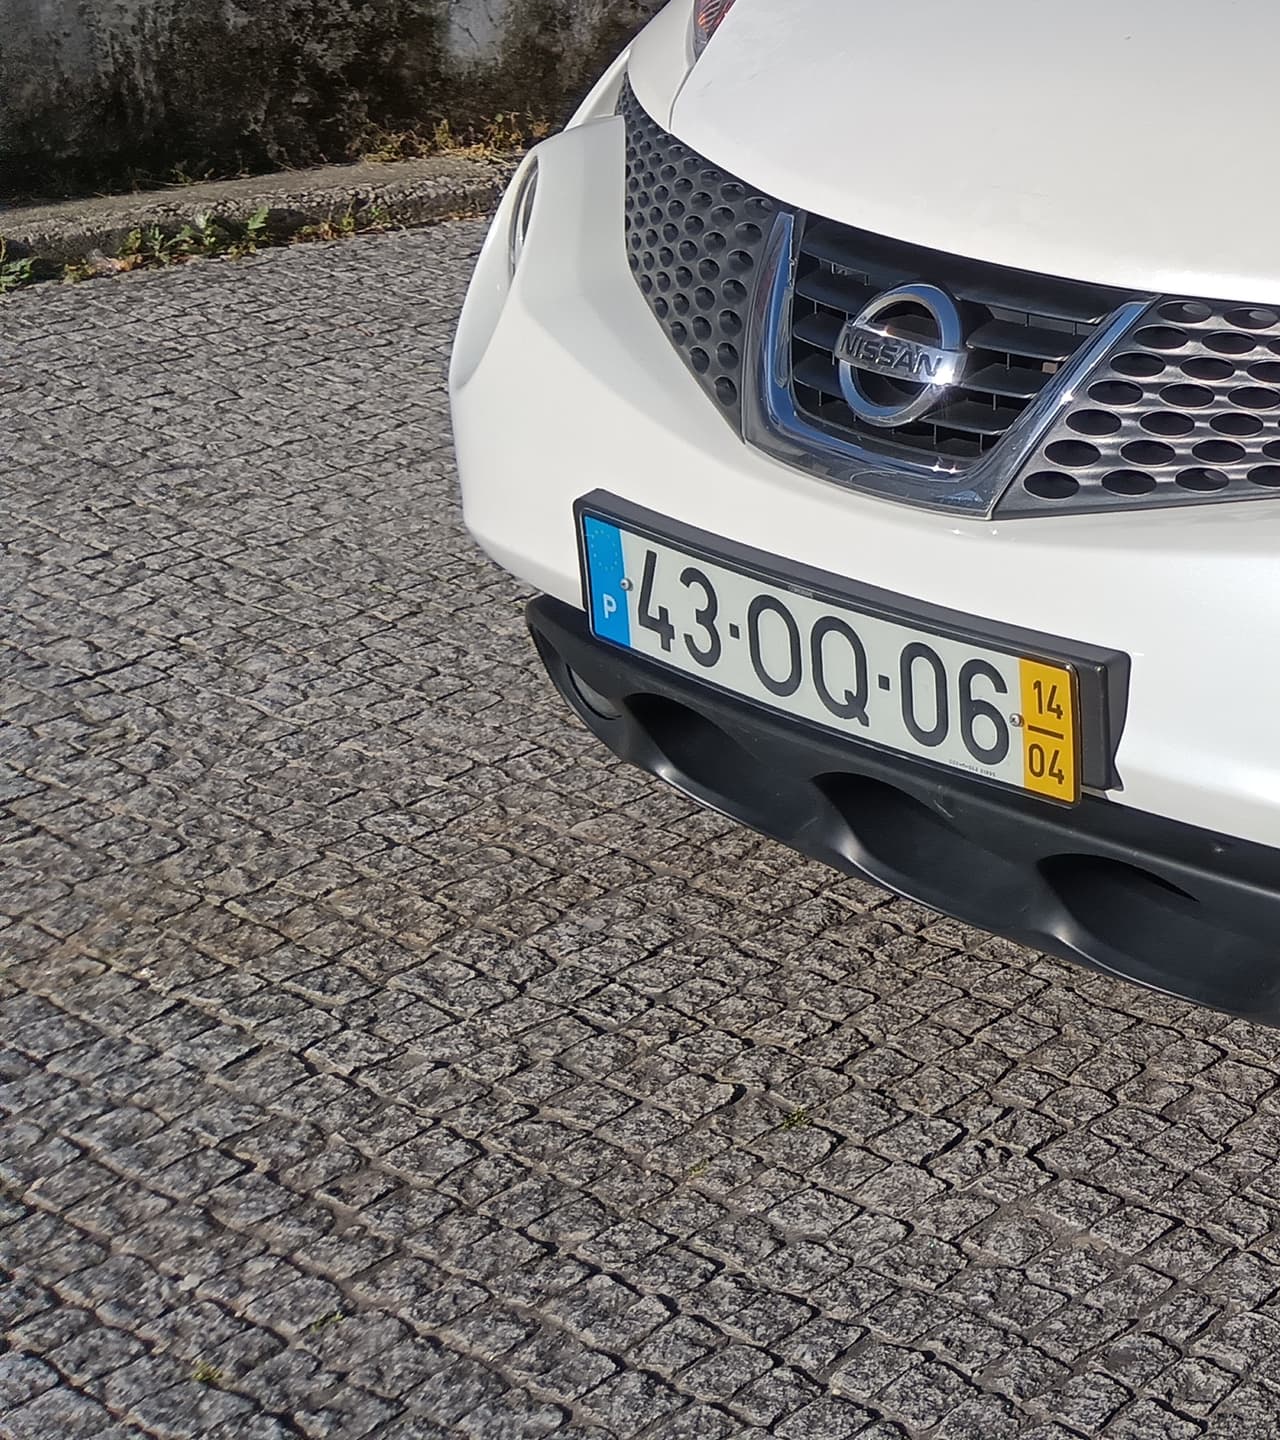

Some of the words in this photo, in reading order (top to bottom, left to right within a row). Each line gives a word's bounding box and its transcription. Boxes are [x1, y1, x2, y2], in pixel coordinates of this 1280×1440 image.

[840, 332, 942, 377] NISSAN
[602, 593, 617, 619] P
[1032, 679, 1064, 720] 14
[1028, 743, 1065, 785] 04
